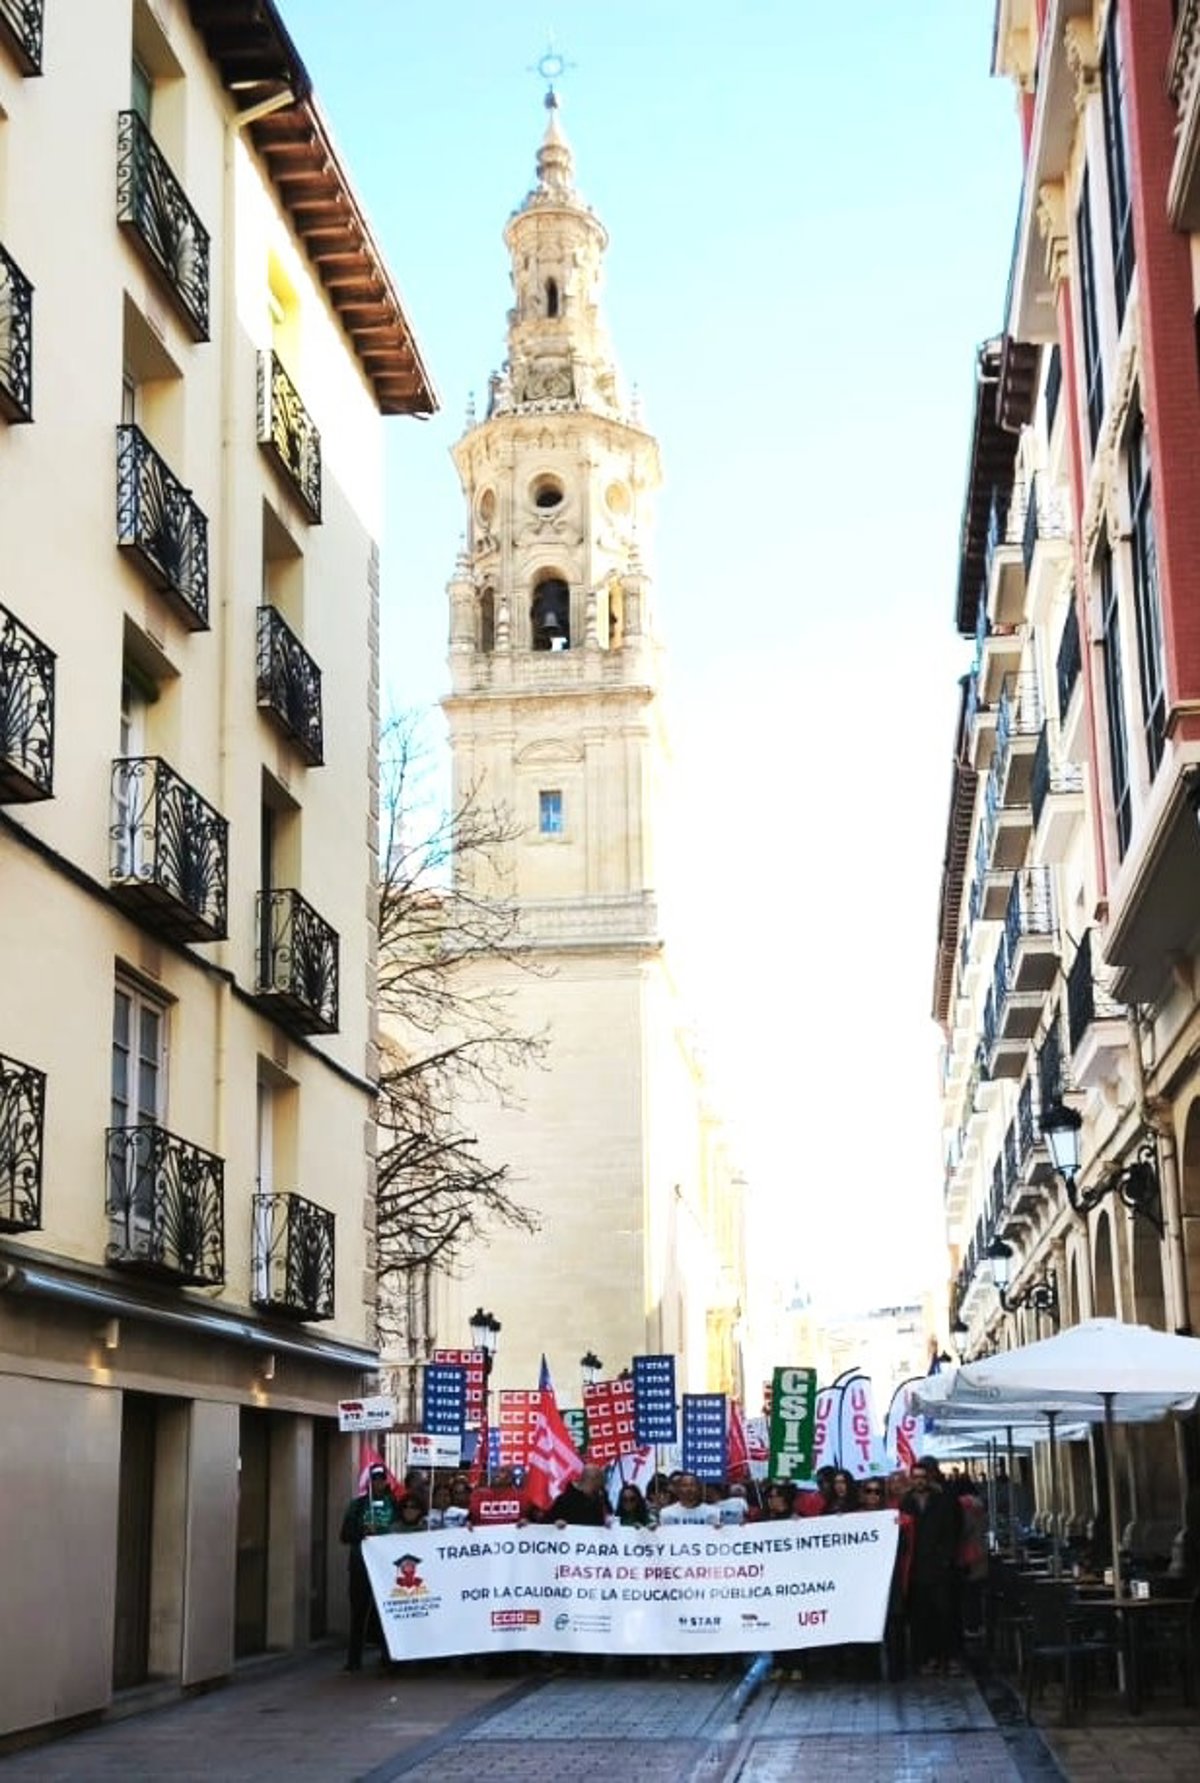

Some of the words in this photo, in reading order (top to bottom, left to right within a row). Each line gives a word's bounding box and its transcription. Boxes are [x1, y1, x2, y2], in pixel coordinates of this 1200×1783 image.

[696, 1413, 721, 1421] STAR
[776, 1370, 809, 1477] CSIF
[696, 1427, 721, 1435] STAR
[851, 1388, 871, 1462] UGT
[696, 1441, 721, 1449] STAR
[696, 1455, 721, 1463] STAR
[480, 1501, 520, 1514] CCOO
[437, 1541, 515, 1560] TRABAJO
[518, 1541, 570, 1555] DIGNO
[575, 1543, 619, 1556] PARA
[671, 1543, 701, 1556] LAS
[705, 1538, 792, 1556] DOCENTES
[796, 1530, 879, 1550] INTERINAS
[555, 1564, 612, 1580] ¡BASTA
[616, 1566, 640, 1580] DE
[644, 1564, 764, 1580] PRECARIEDAD!
[461, 1588, 490, 1601] POR
[494, 1586, 511, 1598] LA
[514, 1586, 572, 1599] CALIDAD
[577, 1588, 598, 1599] DE
[601, 1588, 618, 1600] LA
[621, 1586, 705, 1601] EDUCACIÓN
[775, 1580, 836, 1596] RIOJANA
[494, 1612, 525, 1623] CCOO
[690, 1616, 721, 1627] STAR
[797, 1610, 828, 1626] UGT
